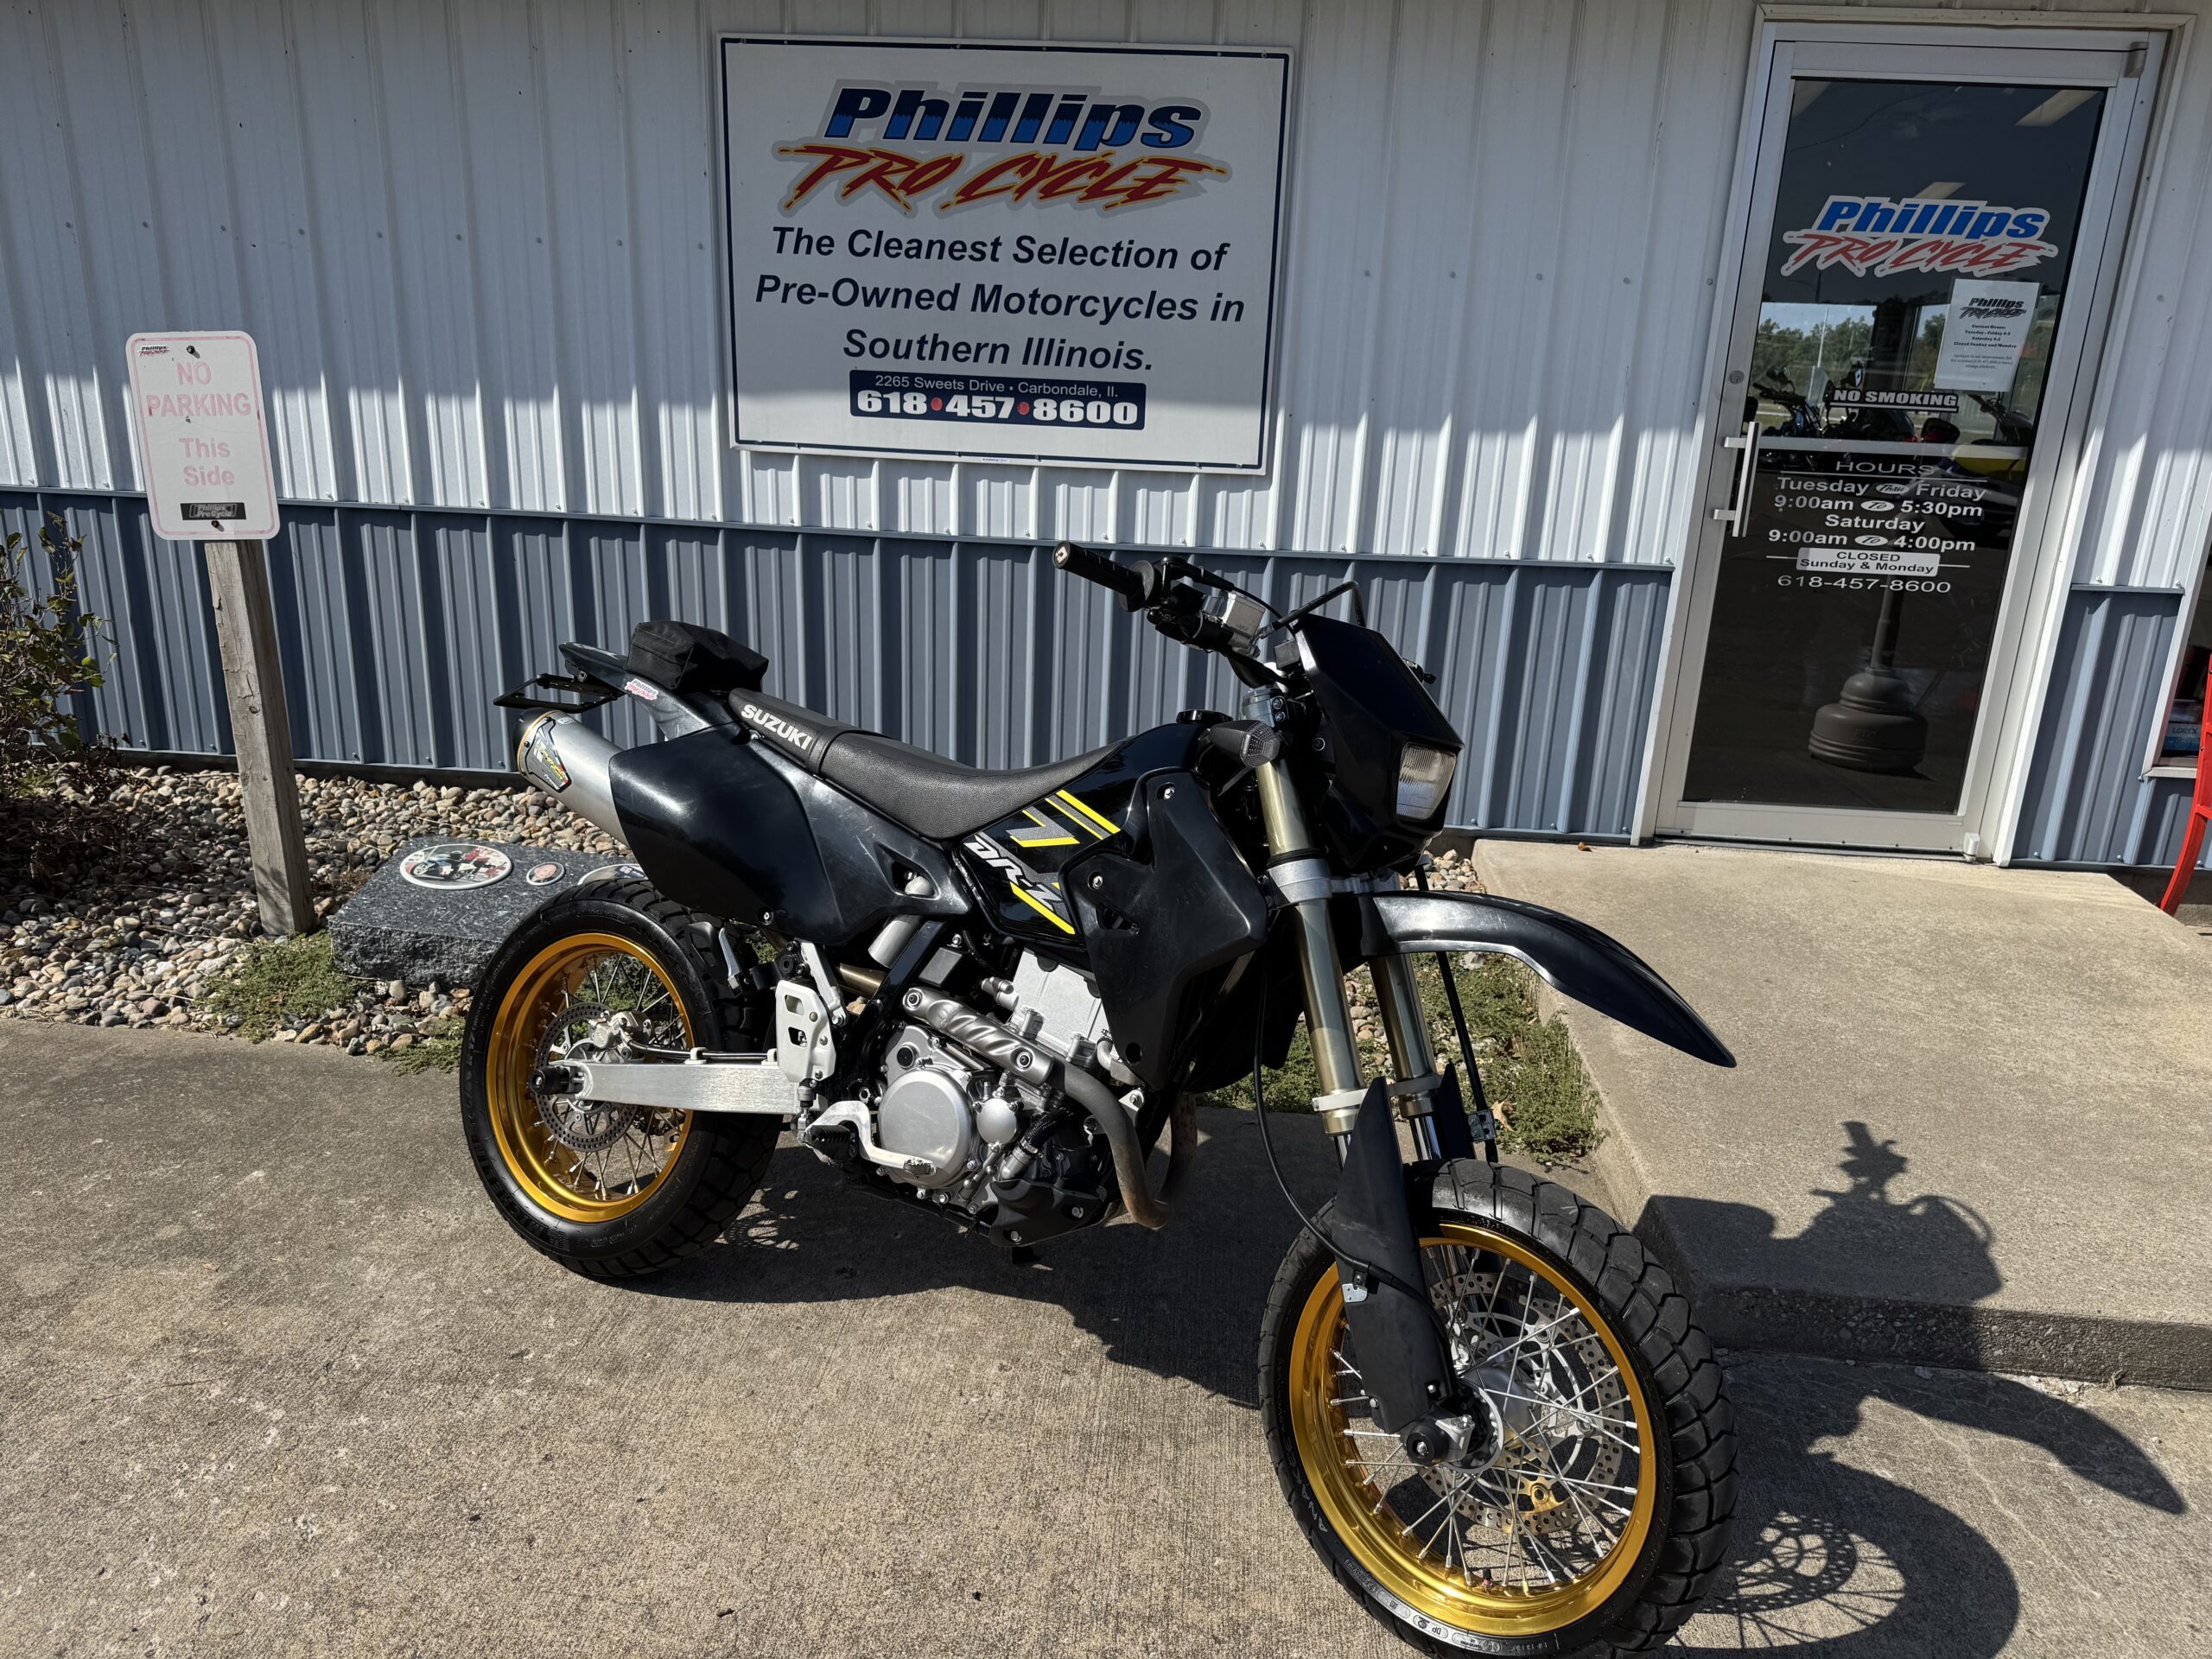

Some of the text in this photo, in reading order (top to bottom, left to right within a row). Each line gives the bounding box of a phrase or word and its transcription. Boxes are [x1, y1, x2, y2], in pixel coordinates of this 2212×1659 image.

[824, 87, 1201, 150] Phillips
[779, 144, 1227, 210] PRO CYCLE
[1816, 201, 2045, 239] Phillips
[772, 226, 1230, 270] The Cleanest Selection of
[1785, 232, 2053, 273] PRO CYCLE
[756, 275, 1245, 326] Pre-Owned Motorcycles in
[1968, 298, 2024, 308] Phillips
[843, 329, 1153, 370] Southern Illinois.
[176, 361, 212, 385] NO
[874, 375, 910, 390] 2265
[913, 376, 964, 391] Sweets
[969, 378, 1005, 392] Drive
[1018, 380, 1103, 398] Carbondale,
[146, 392, 251, 416] PARKING
[1834, 390, 1958, 407] NO SMOKING
[179, 437, 231, 458] This
[183, 466, 235, 486] Side
[1835, 461, 1935, 475] HOURS
[1777, 477, 1987, 501] Tuesday Thru Friday
[1774, 495, 1983, 518] 9:00am To 5:30pm
[1825, 514, 1925, 533] Saturday
[1768, 530, 1976, 553] 9:00am To 4:00pm
[1800, 558, 1855, 571] Sunday
[1875, 563, 1935, 575] Monday
[1836, 551, 1901, 563] CLOSED
[1777, 575, 1952, 594] 618-457-8600
[741, 704, 813, 750] SUZUKI
[1284, 1437, 1328, 1533] ANAKEE
